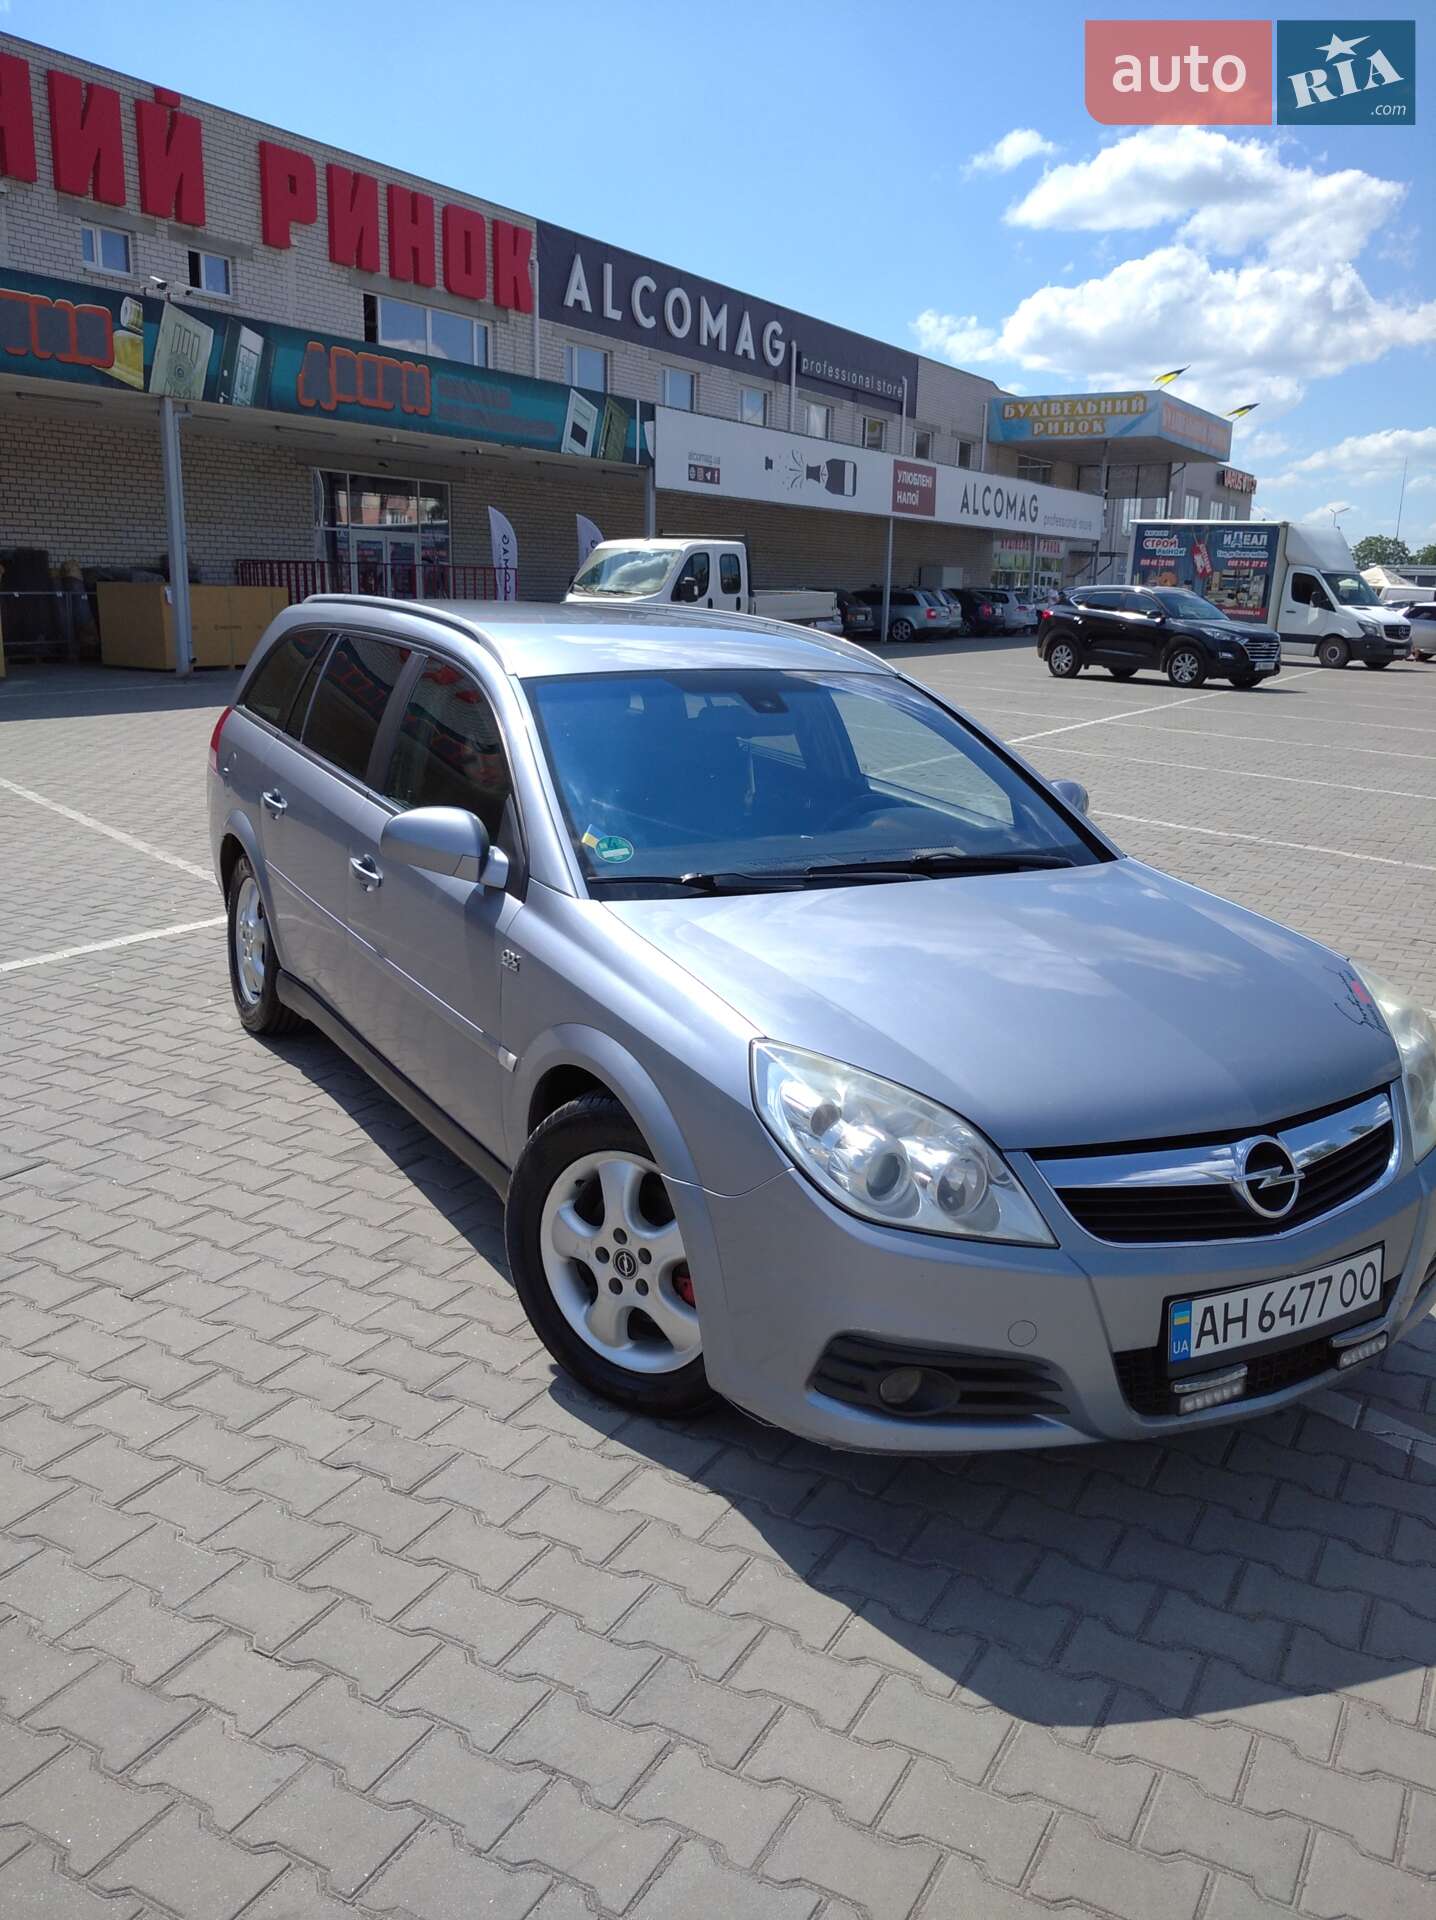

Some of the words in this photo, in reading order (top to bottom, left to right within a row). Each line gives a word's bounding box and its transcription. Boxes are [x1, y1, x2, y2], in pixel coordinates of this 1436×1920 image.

[258, 140, 534, 314] РИНОК
[563, 253, 786, 368] ALCOMAG
[801, 358, 874, 390] professional
[876, 380, 903, 397] store
[1003, 394, 1147, 420] БУДІВЕЛЬНИЙ
[1032, 419, 1105, 436] РИНОК
[896, 469, 933, 489] УЛЮБЛЕНІ
[896, 489, 920, 506] НАПОЇ
[960, 482, 1039, 523] ALCOMAG
[1223, 530, 1268, 548] ИДЕАЛ
[1194, 1297, 1249, 1350] AH
[1257, 1274, 1333, 1334] 6477
[1339, 1261, 1377, 1308] OO
[1172, 1339, 1190, 1354] UA
